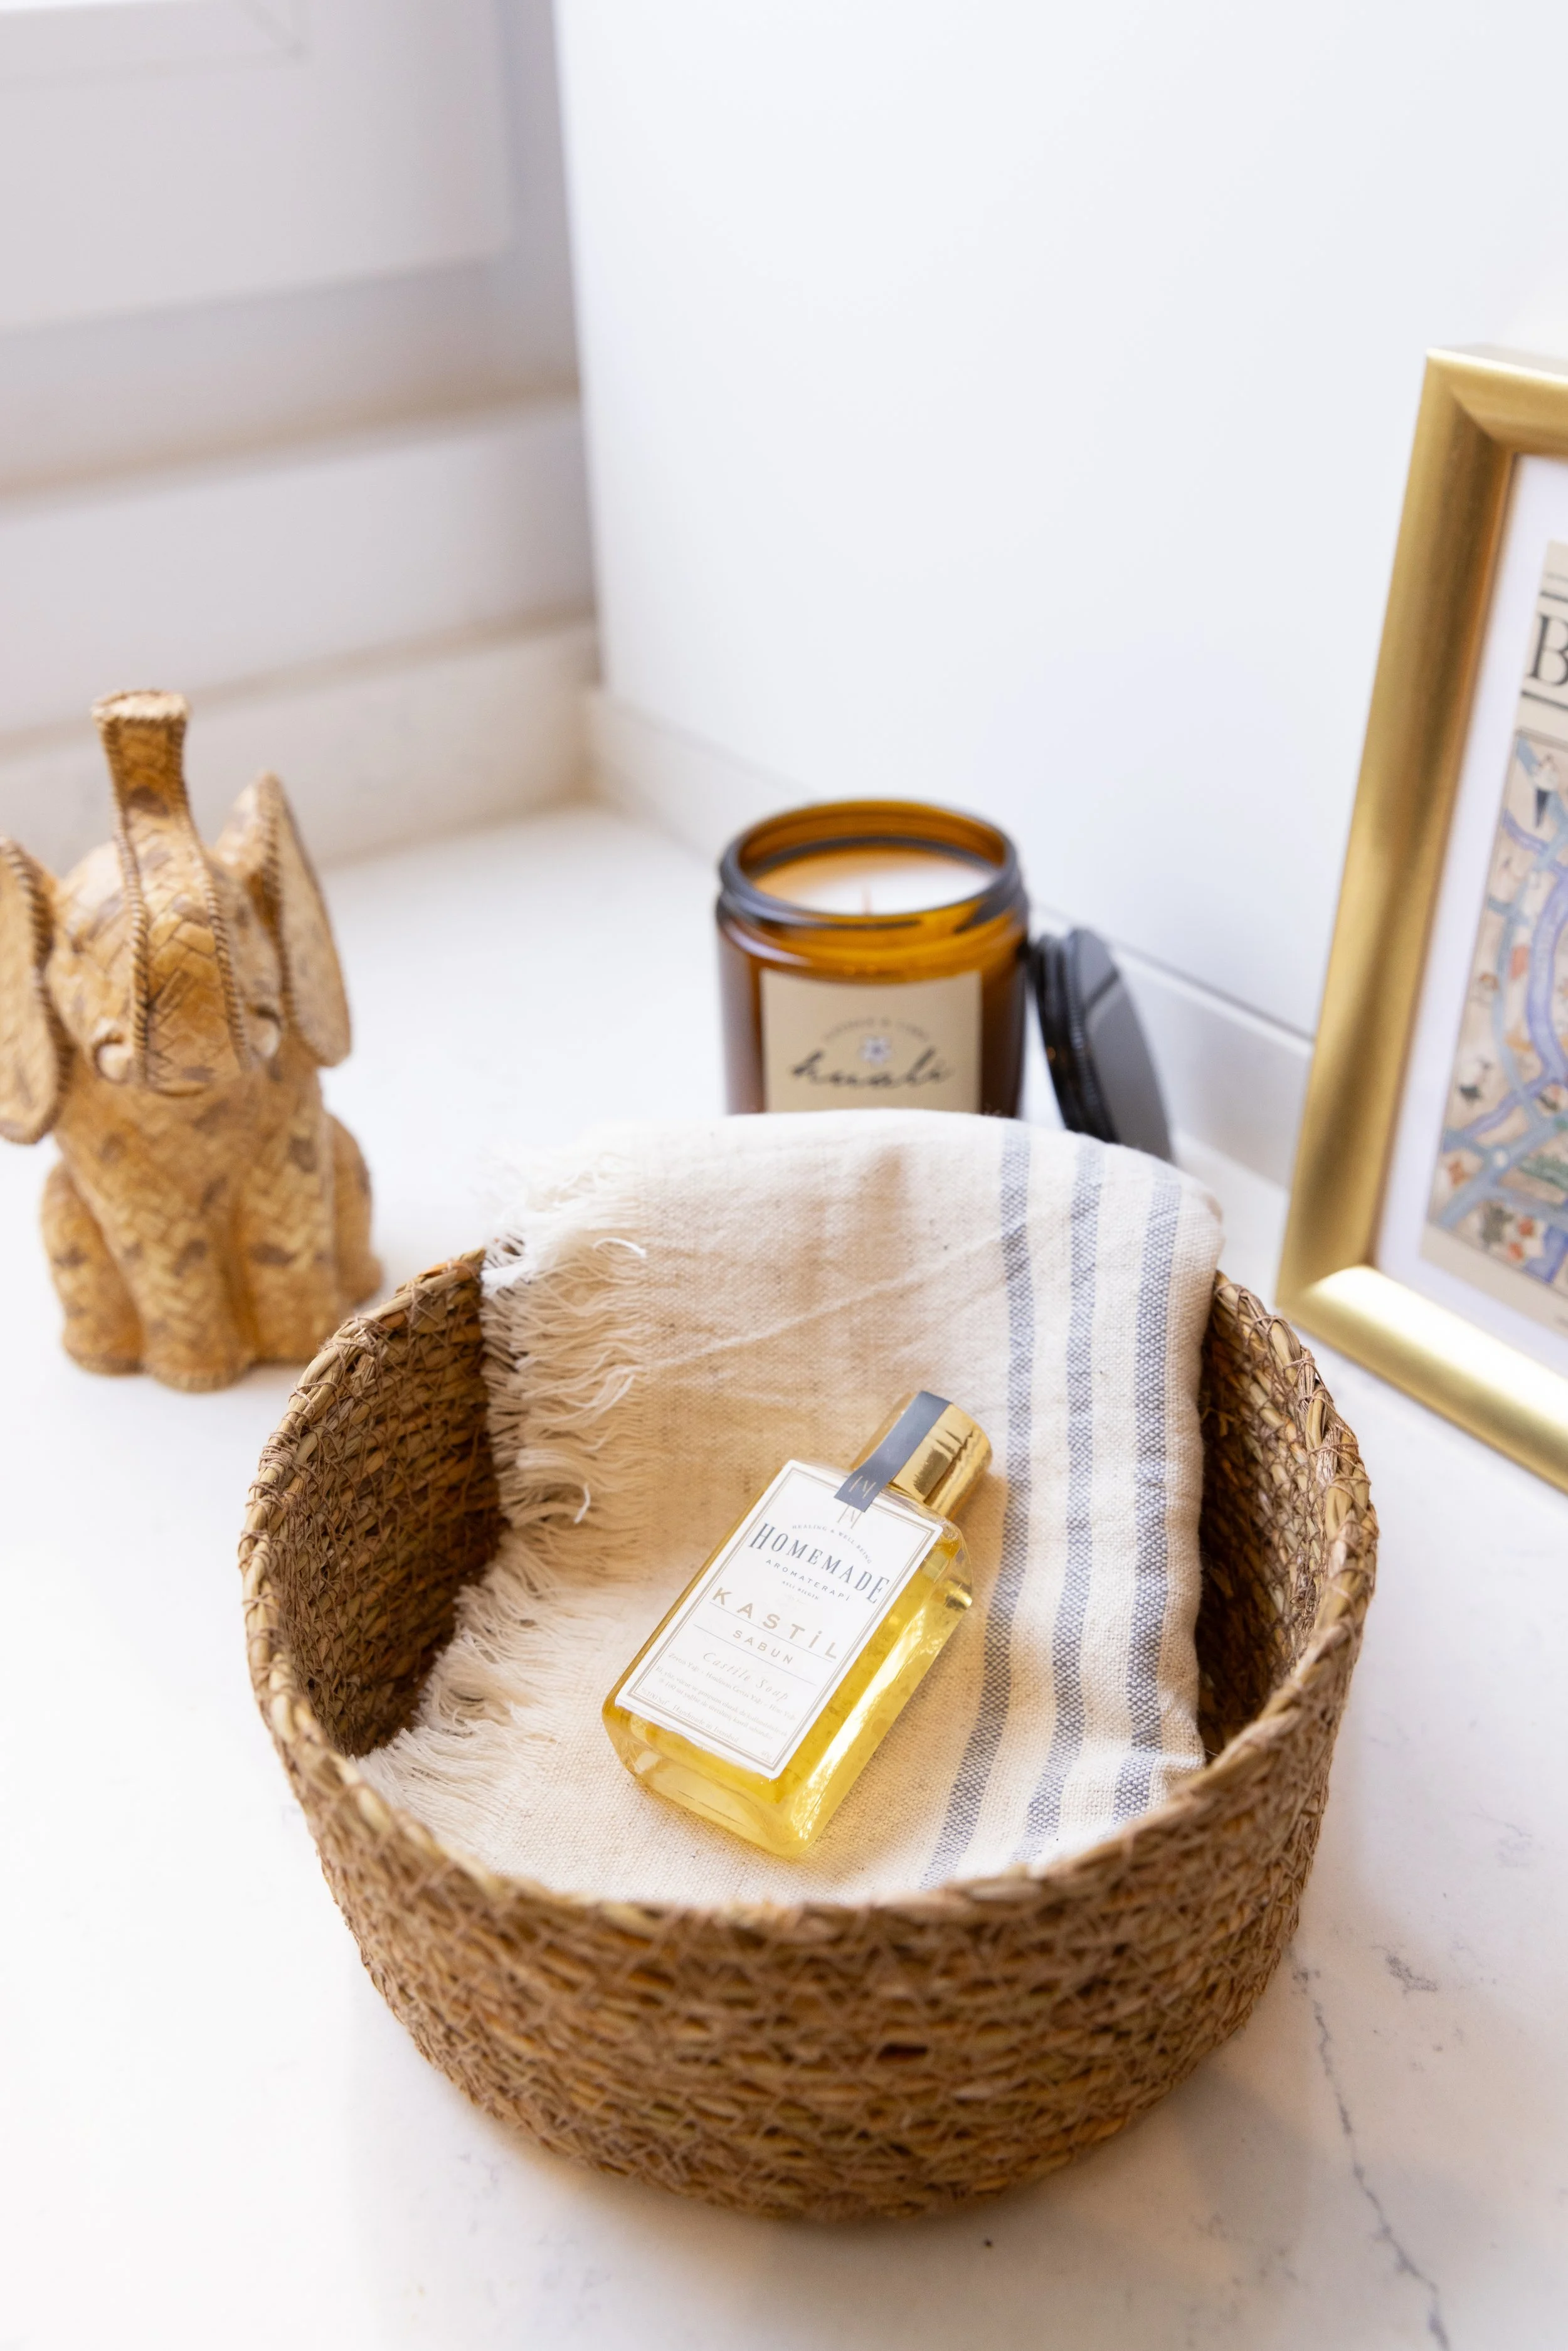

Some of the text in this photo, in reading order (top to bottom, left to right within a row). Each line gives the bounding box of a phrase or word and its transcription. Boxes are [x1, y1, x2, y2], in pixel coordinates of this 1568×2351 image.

[748, 1523, 890, 1603] HOMEMADE
[712, 1587, 837, 1658] KASTİL
[732, 1629, 793, 1664] SABUN
[702, 1652, 788, 1702] Castile Soap
